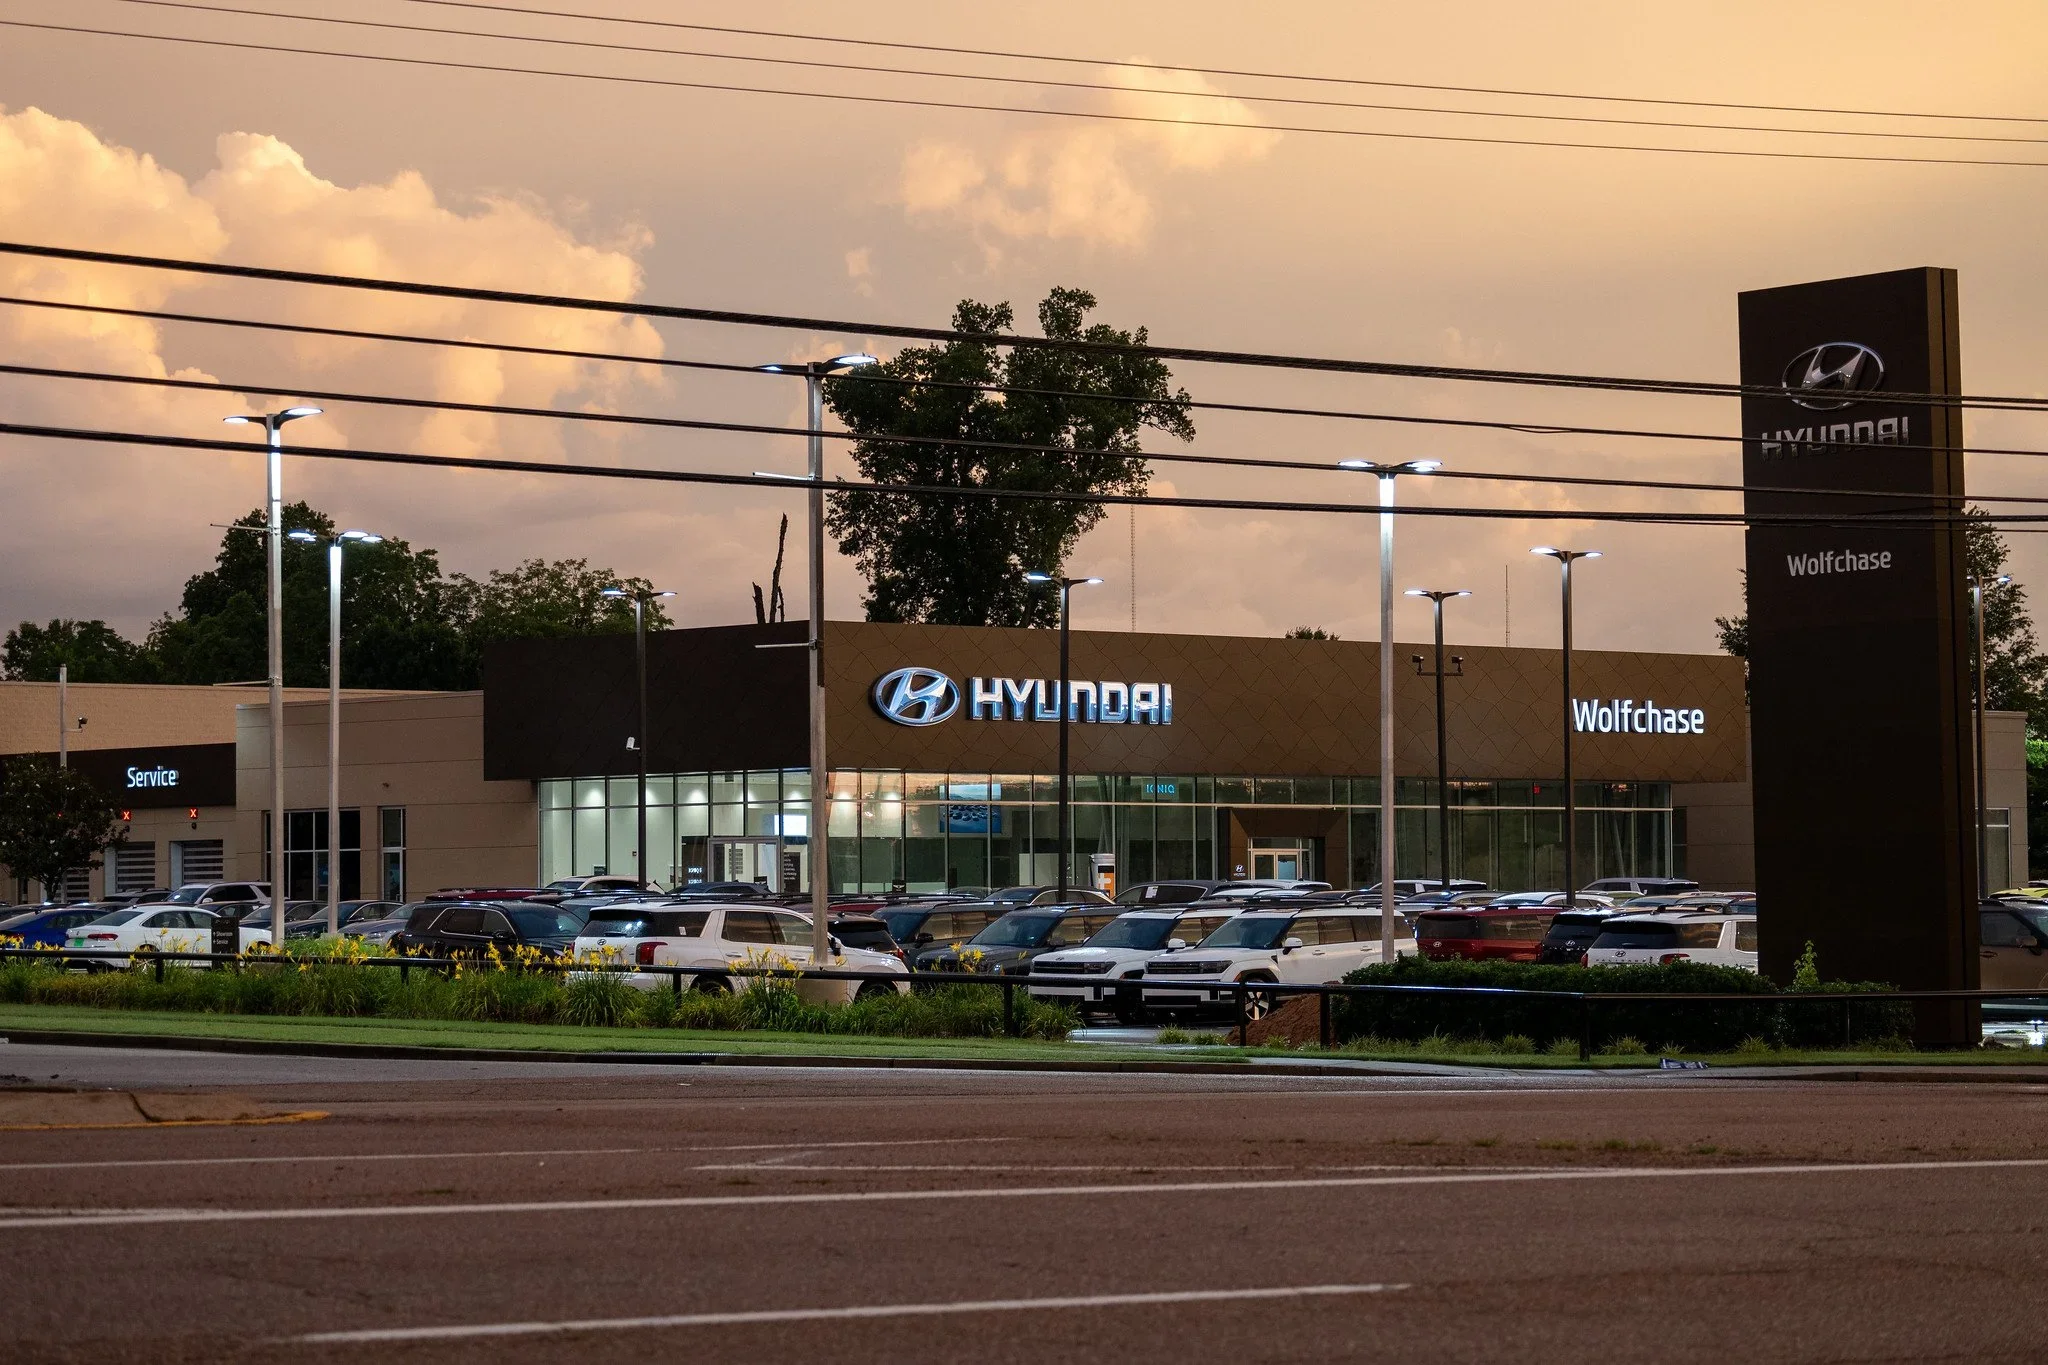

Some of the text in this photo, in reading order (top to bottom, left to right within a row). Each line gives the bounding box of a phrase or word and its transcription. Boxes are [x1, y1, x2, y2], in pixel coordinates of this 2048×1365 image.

[1761, 416, 1909, 460] HYUNDAI
[1787, 550, 1891, 577] Wolfchase
[970, 676, 1173, 725] HYUNDAI
[1572, 698, 1705, 734] Wolfchase
[127, 766, 179, 788] Service
